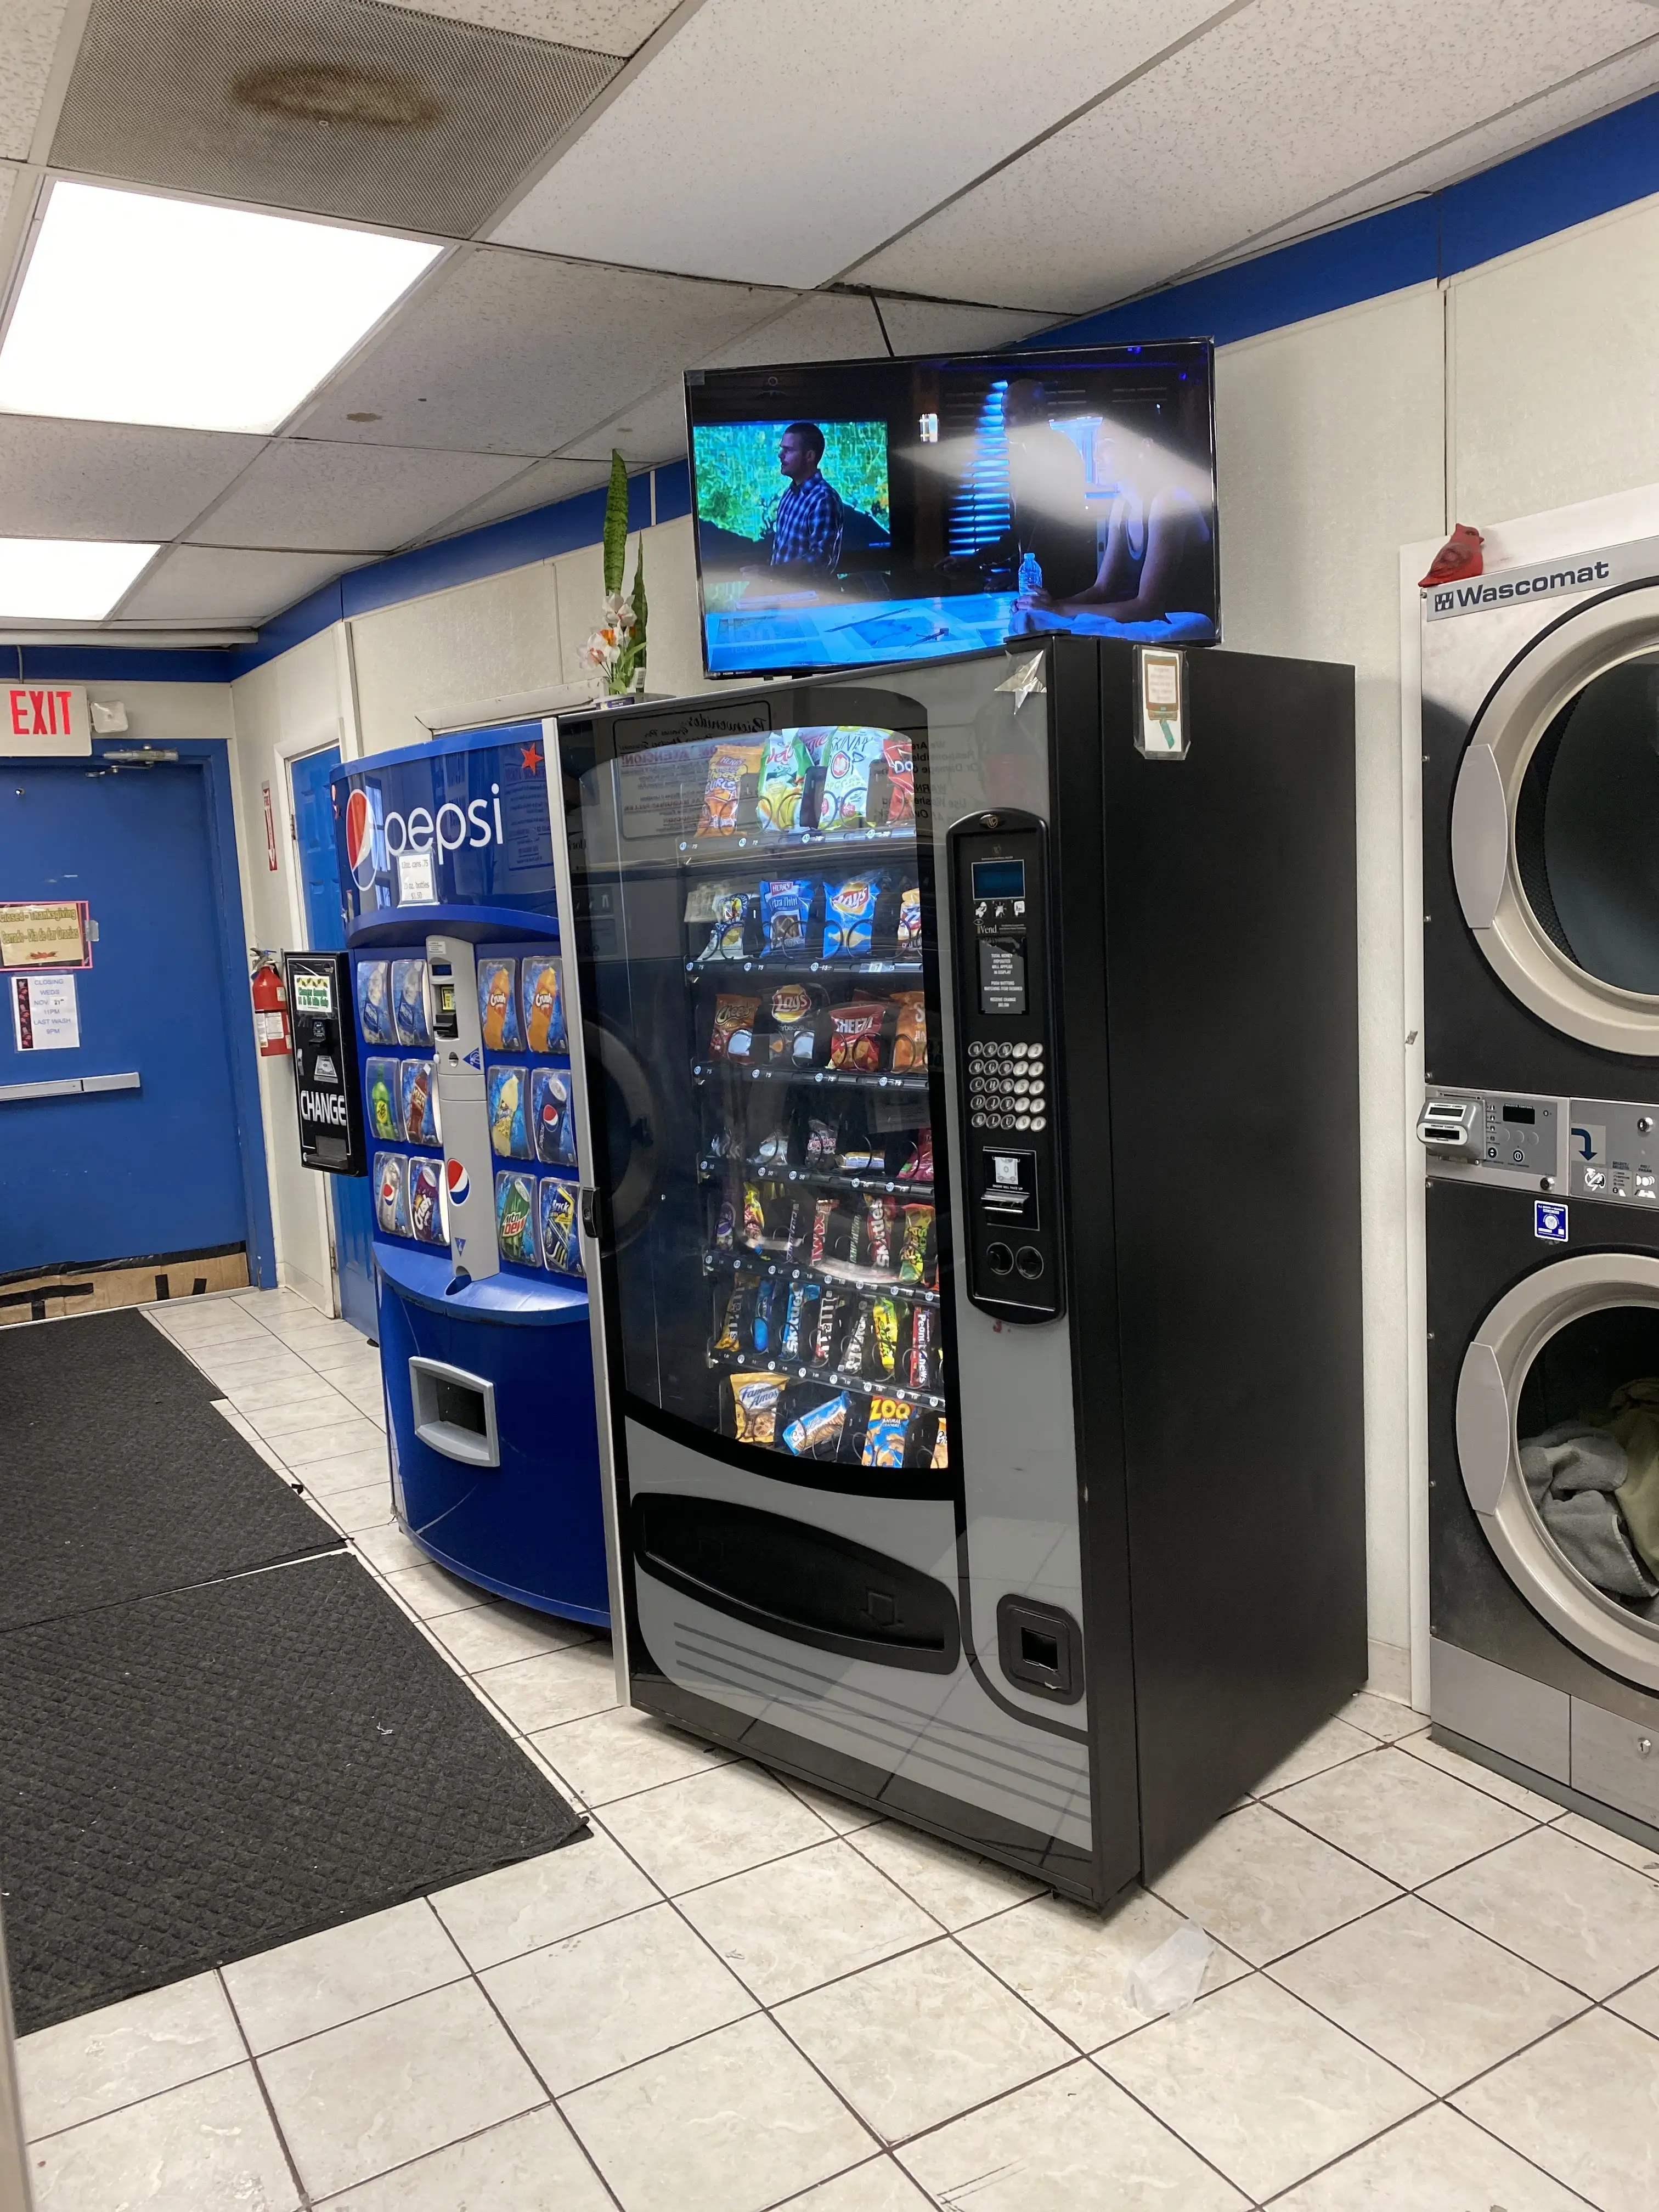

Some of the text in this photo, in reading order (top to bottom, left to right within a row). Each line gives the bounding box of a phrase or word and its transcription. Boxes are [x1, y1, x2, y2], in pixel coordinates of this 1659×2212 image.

[1457, 561, 1609, 607] Wascomat
[9, 690, 72, 735] EXIT
[384, 783, 504, 872] pepsi
[772, 882, 791, 892] HERR'S
[783, 896, 798, 906] Thin
[0, 907, 77, 922] Closed Thanksgiving
[490, 992, 506, 1007] Crush
[535, 992, 552, 1007] Crush
[301, 1090, 347, 1126] CHANGE
[414, 1194, 432, 1230] Crush
[811, 1215, 826, 1267] TWIX
[871, 1198, 890, 1269] Skittles
[785, 1288, 805, 1353] Skittles
[917, 1313, 929, 1384] Peanut Chews
[748, 1390, 778, 1410] Amos
[870, 1398, 911, 1421] ZOO
